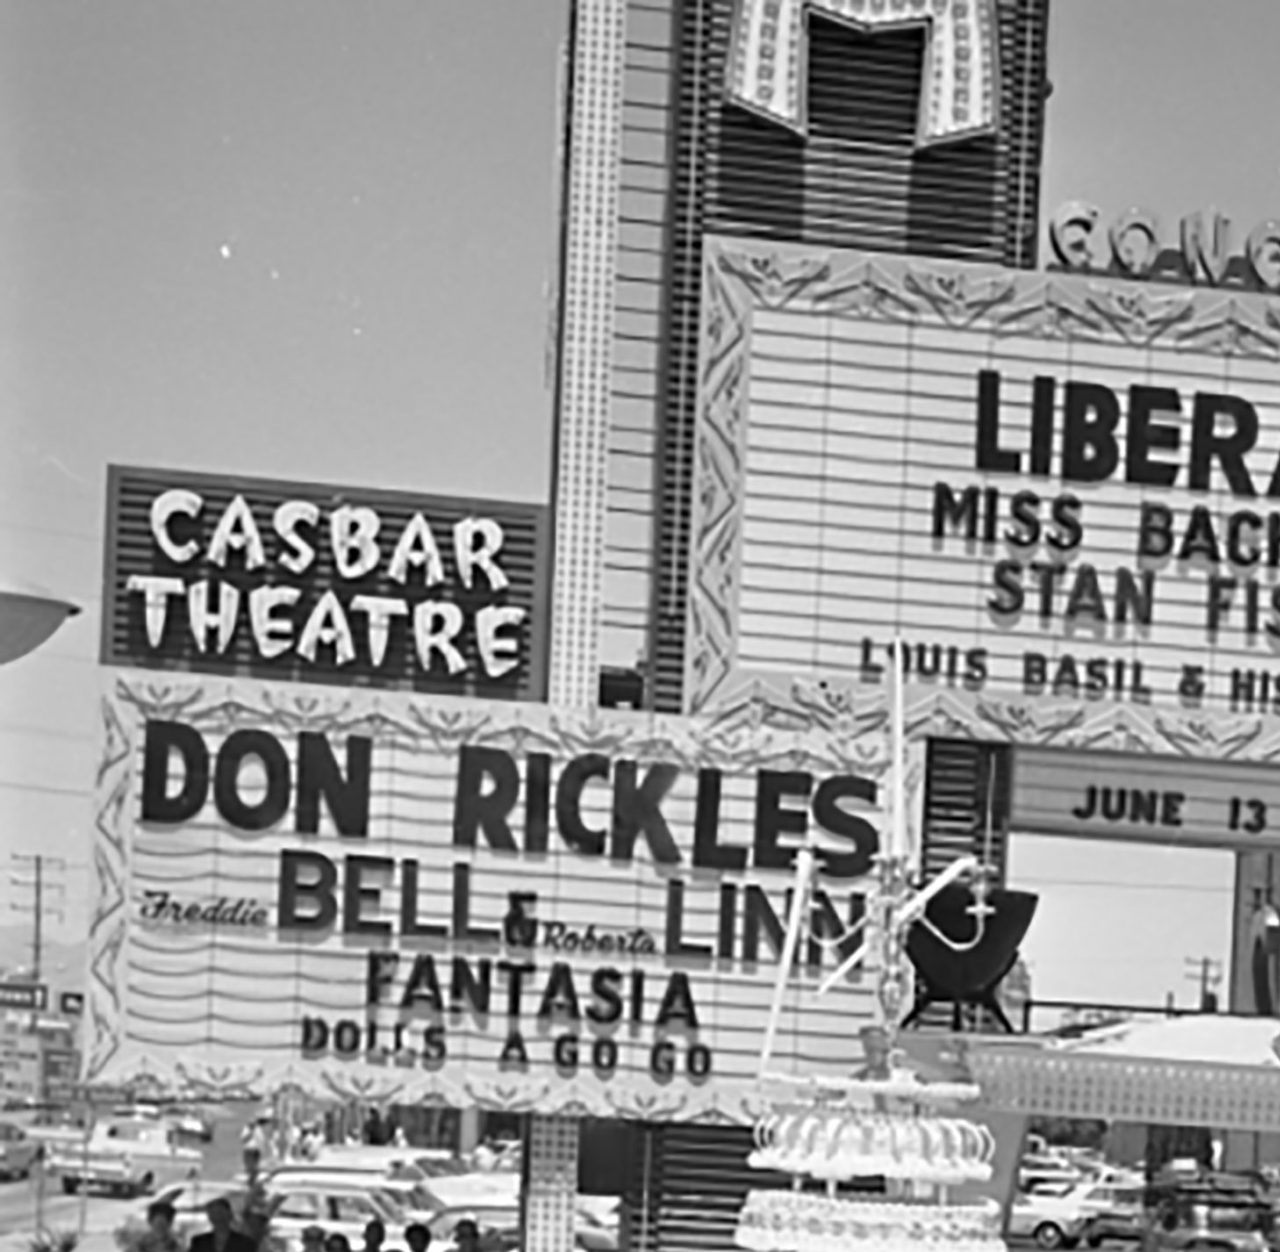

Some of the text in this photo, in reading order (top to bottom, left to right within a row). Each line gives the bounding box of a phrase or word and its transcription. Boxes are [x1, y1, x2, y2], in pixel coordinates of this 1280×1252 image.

[149, 488, 510, 591] CASBAR
[931, 481, 1084, 553] MISS
[125, 574, 528, 678] THEATRE
[986, 559, 1155, 625] STAN
[1022, 651, 1151, 696] BASIL
[1178, 663, 1205, 697] &
[141, 719, 882, 879] DON RICKLES
[1072, 786, 1186, 827] JUNE
[1228, 796, 1268, 834] 13
[139, 848, 866, 970] Freddie BELL & Roberta LINN
[366, 949, 700, 1029] FANTASIA
[301, 1015, 712, 1078] DOLLS A GO GO
